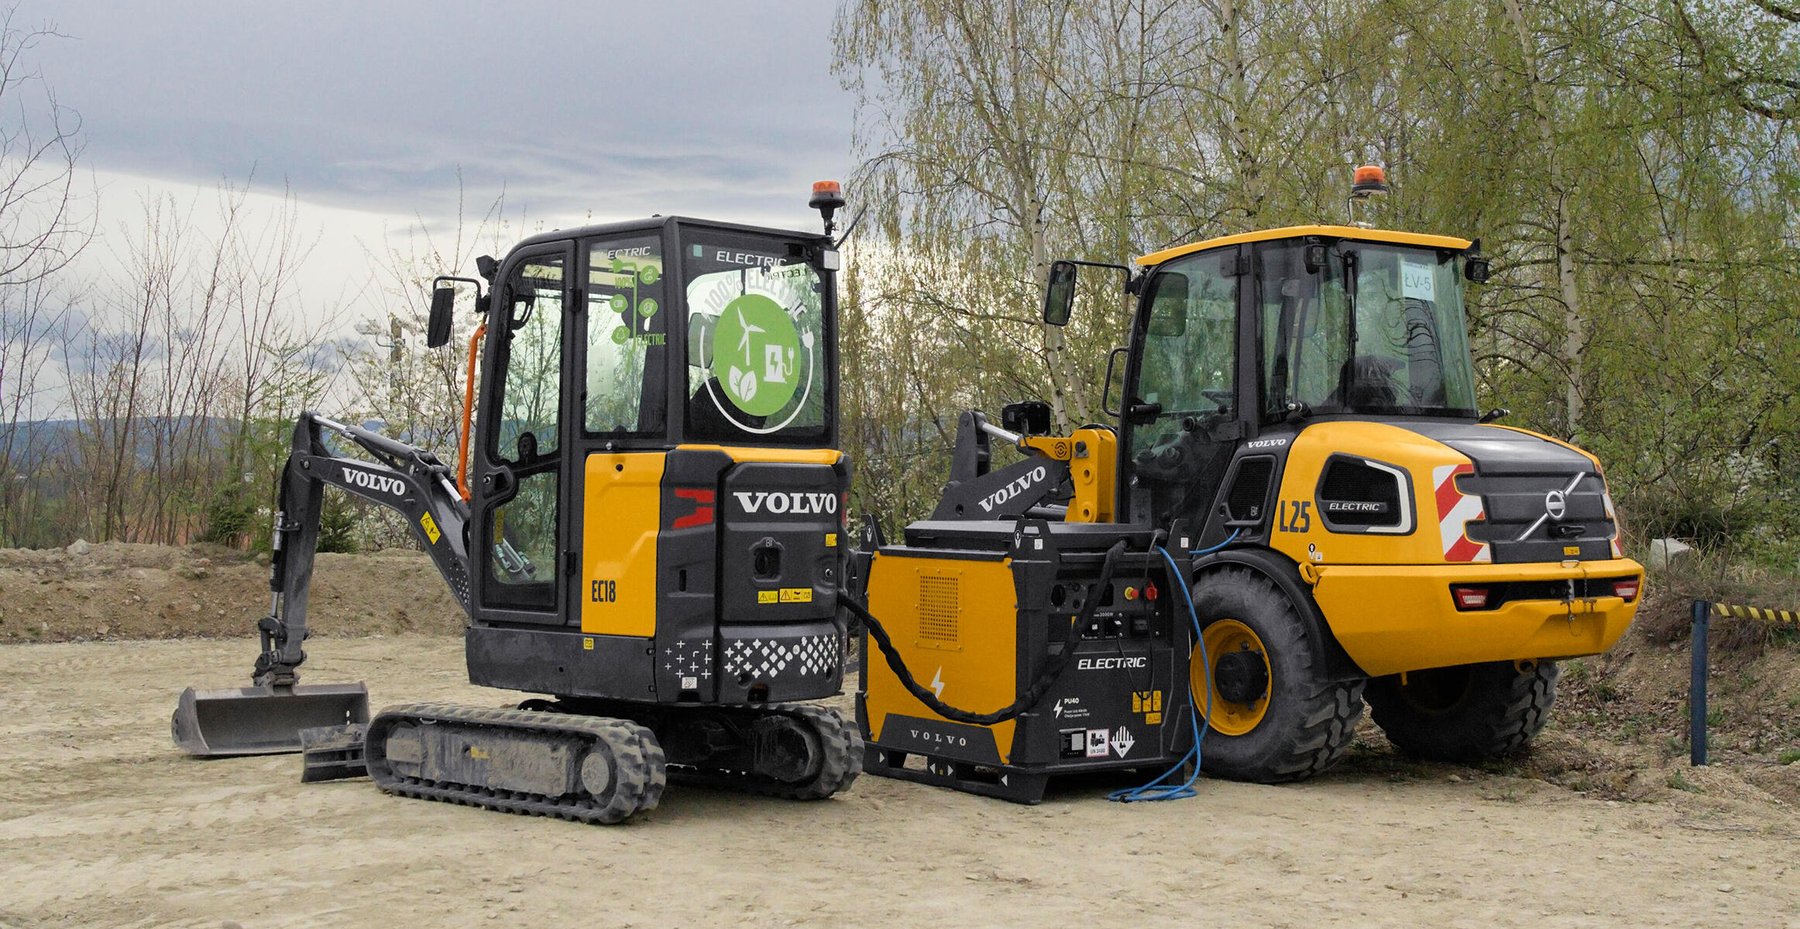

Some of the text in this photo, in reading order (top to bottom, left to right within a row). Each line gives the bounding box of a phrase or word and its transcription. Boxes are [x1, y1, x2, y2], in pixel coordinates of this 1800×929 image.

[716, 250, 787, 267] ELECTRIC
[704, 271, 743, 313] 100%
[1247, 438, 1286, 448] VOLVO
[342, 467, 406, 496] VOLVO
[978, 465, 1047, 513] VOLVO
[733, 491, 837, 514] VOLVO
[1329, 502, 1380, 511] ELECTRIC
[1279, 500, 1311, 533] L25
[591, 580, 616, 603] EC18
[1078, 657, 1146, 670] ELECTRIC
[911, 730, 966, 746] VOLVO
